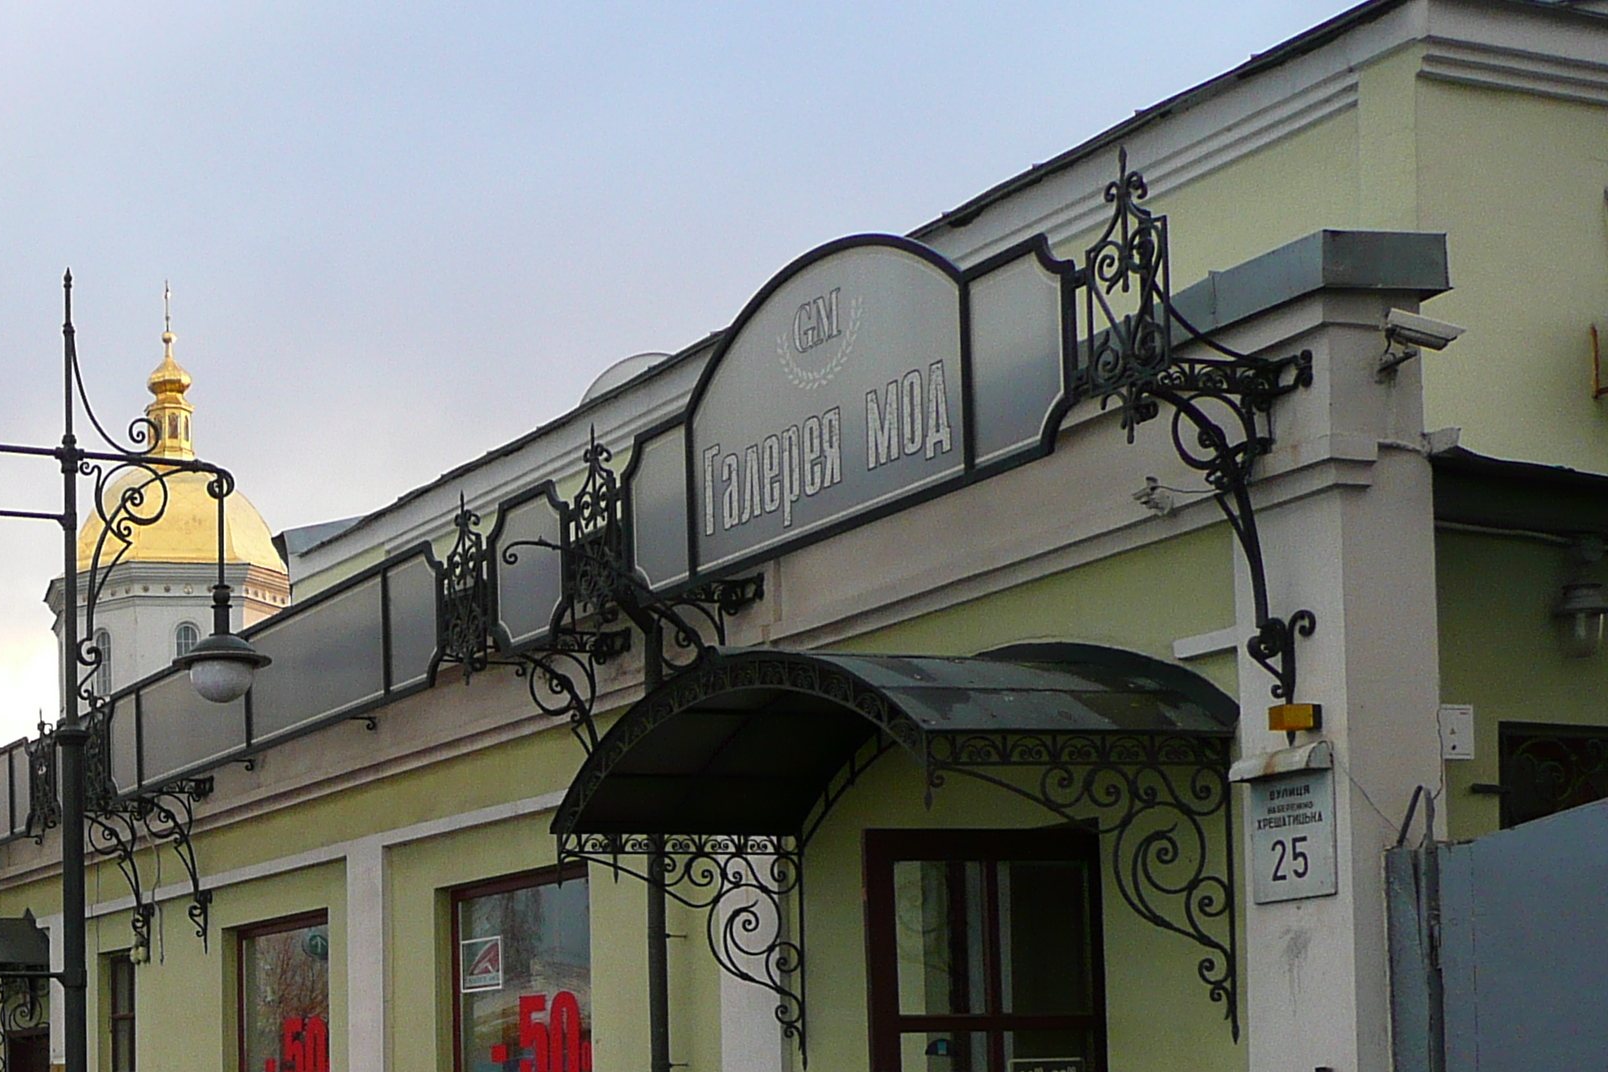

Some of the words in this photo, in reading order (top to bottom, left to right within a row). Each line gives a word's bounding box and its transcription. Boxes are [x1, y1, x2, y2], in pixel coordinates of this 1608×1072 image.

[793, 287, 842, 353] GM
[702, 406, 842, 537] Галерея
[865, 359, 952, 471] МОД
[1271, 836, 1309, 881] 25
